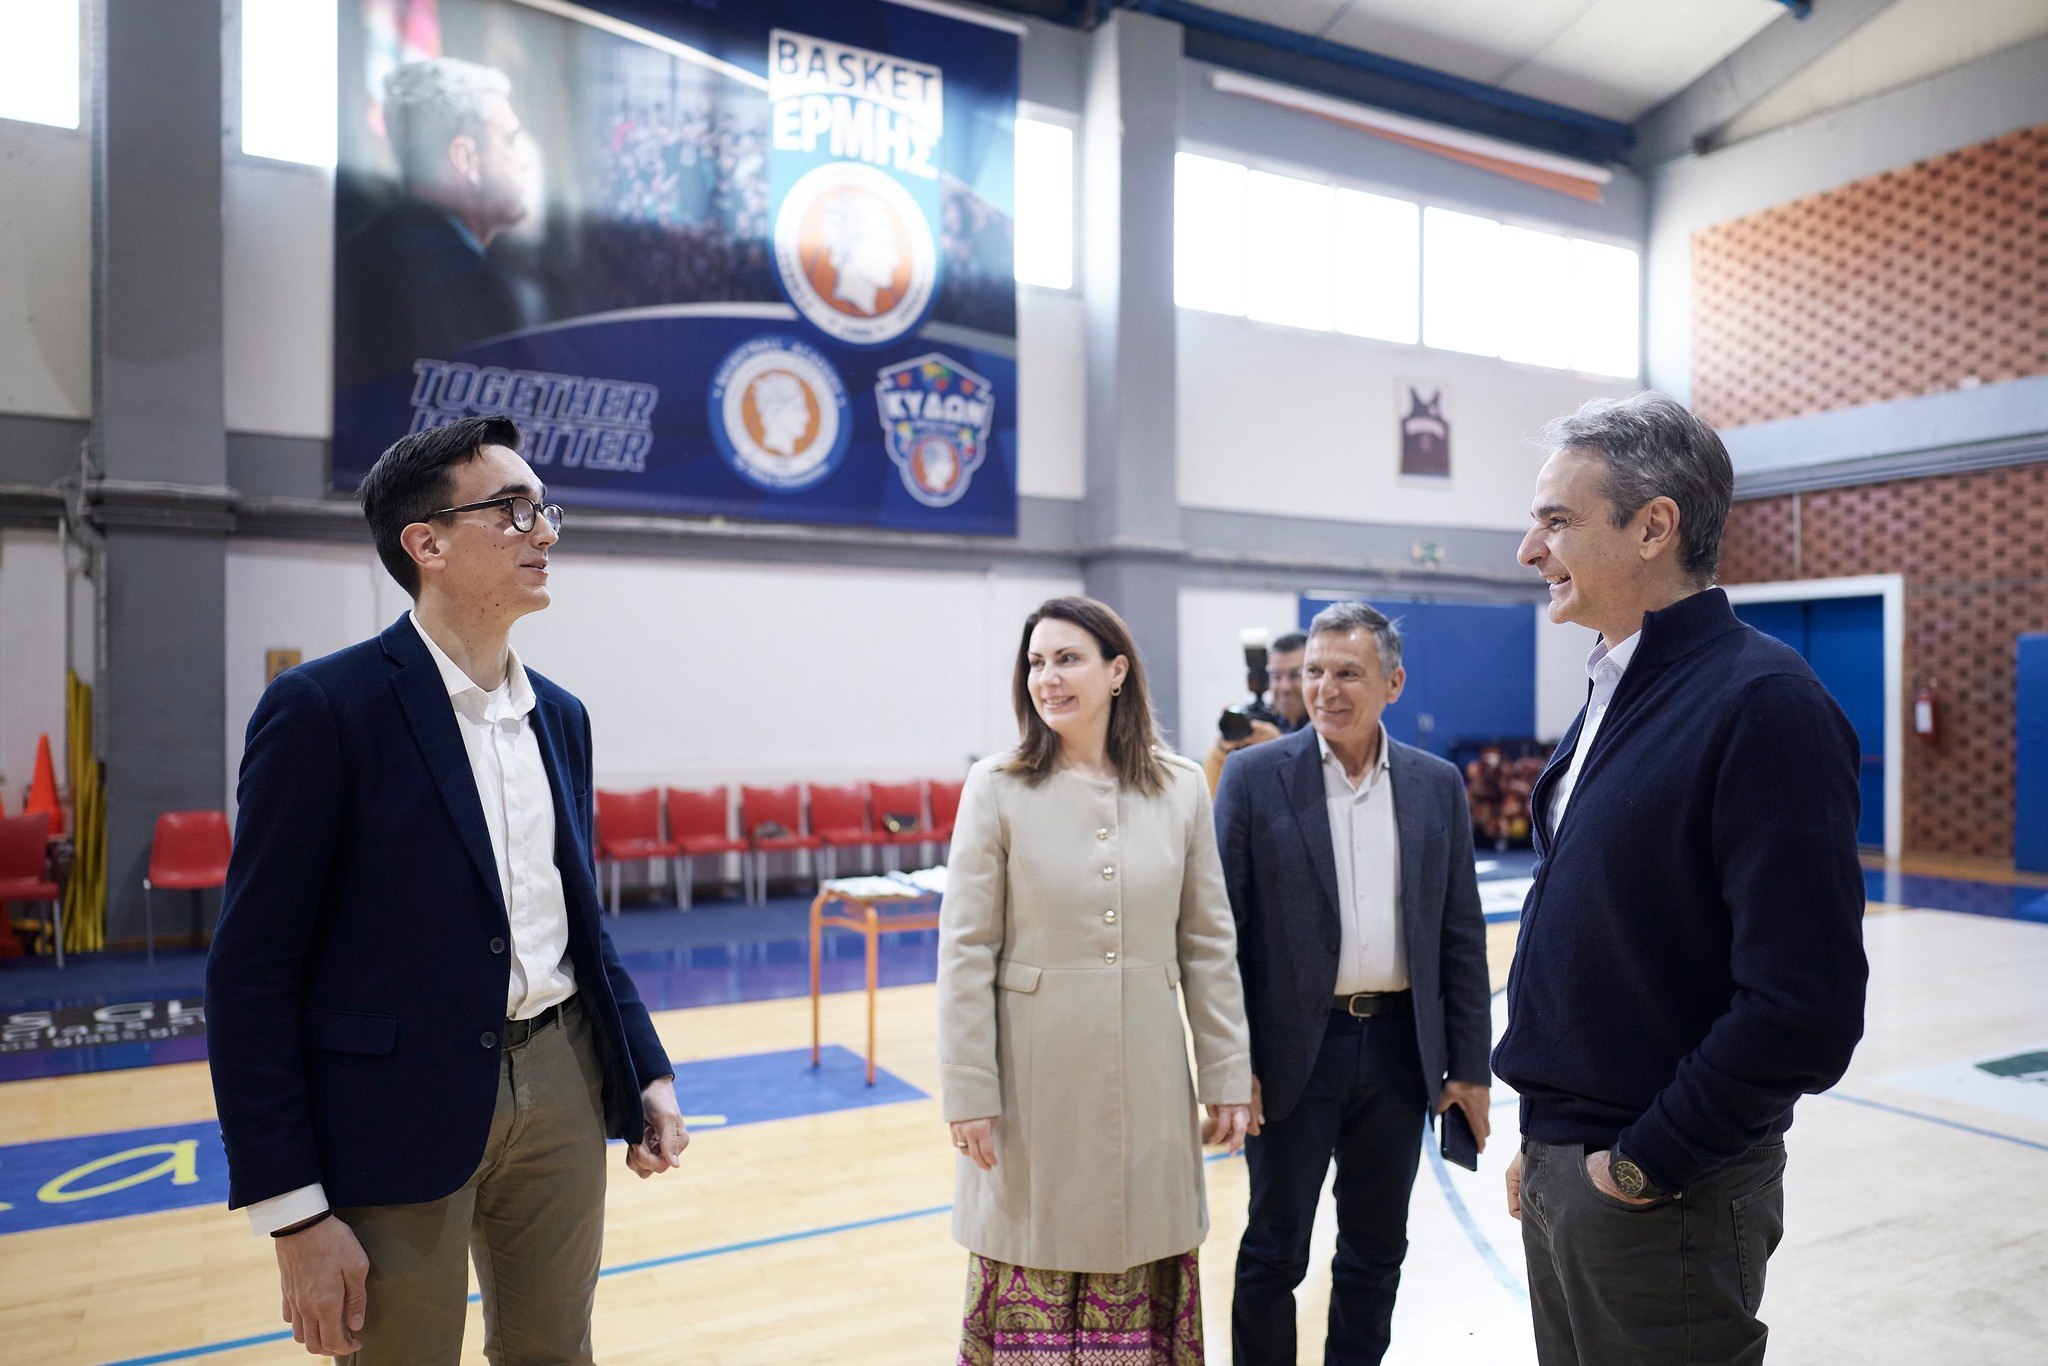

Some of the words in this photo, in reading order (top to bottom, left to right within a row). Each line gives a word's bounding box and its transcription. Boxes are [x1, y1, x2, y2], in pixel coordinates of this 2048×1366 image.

[776, 37, 935, 107] BASKET
[772, 94, 940, 182] ΕΡΜΗΣ
[410, 358, 659, 427] TOGETHER
